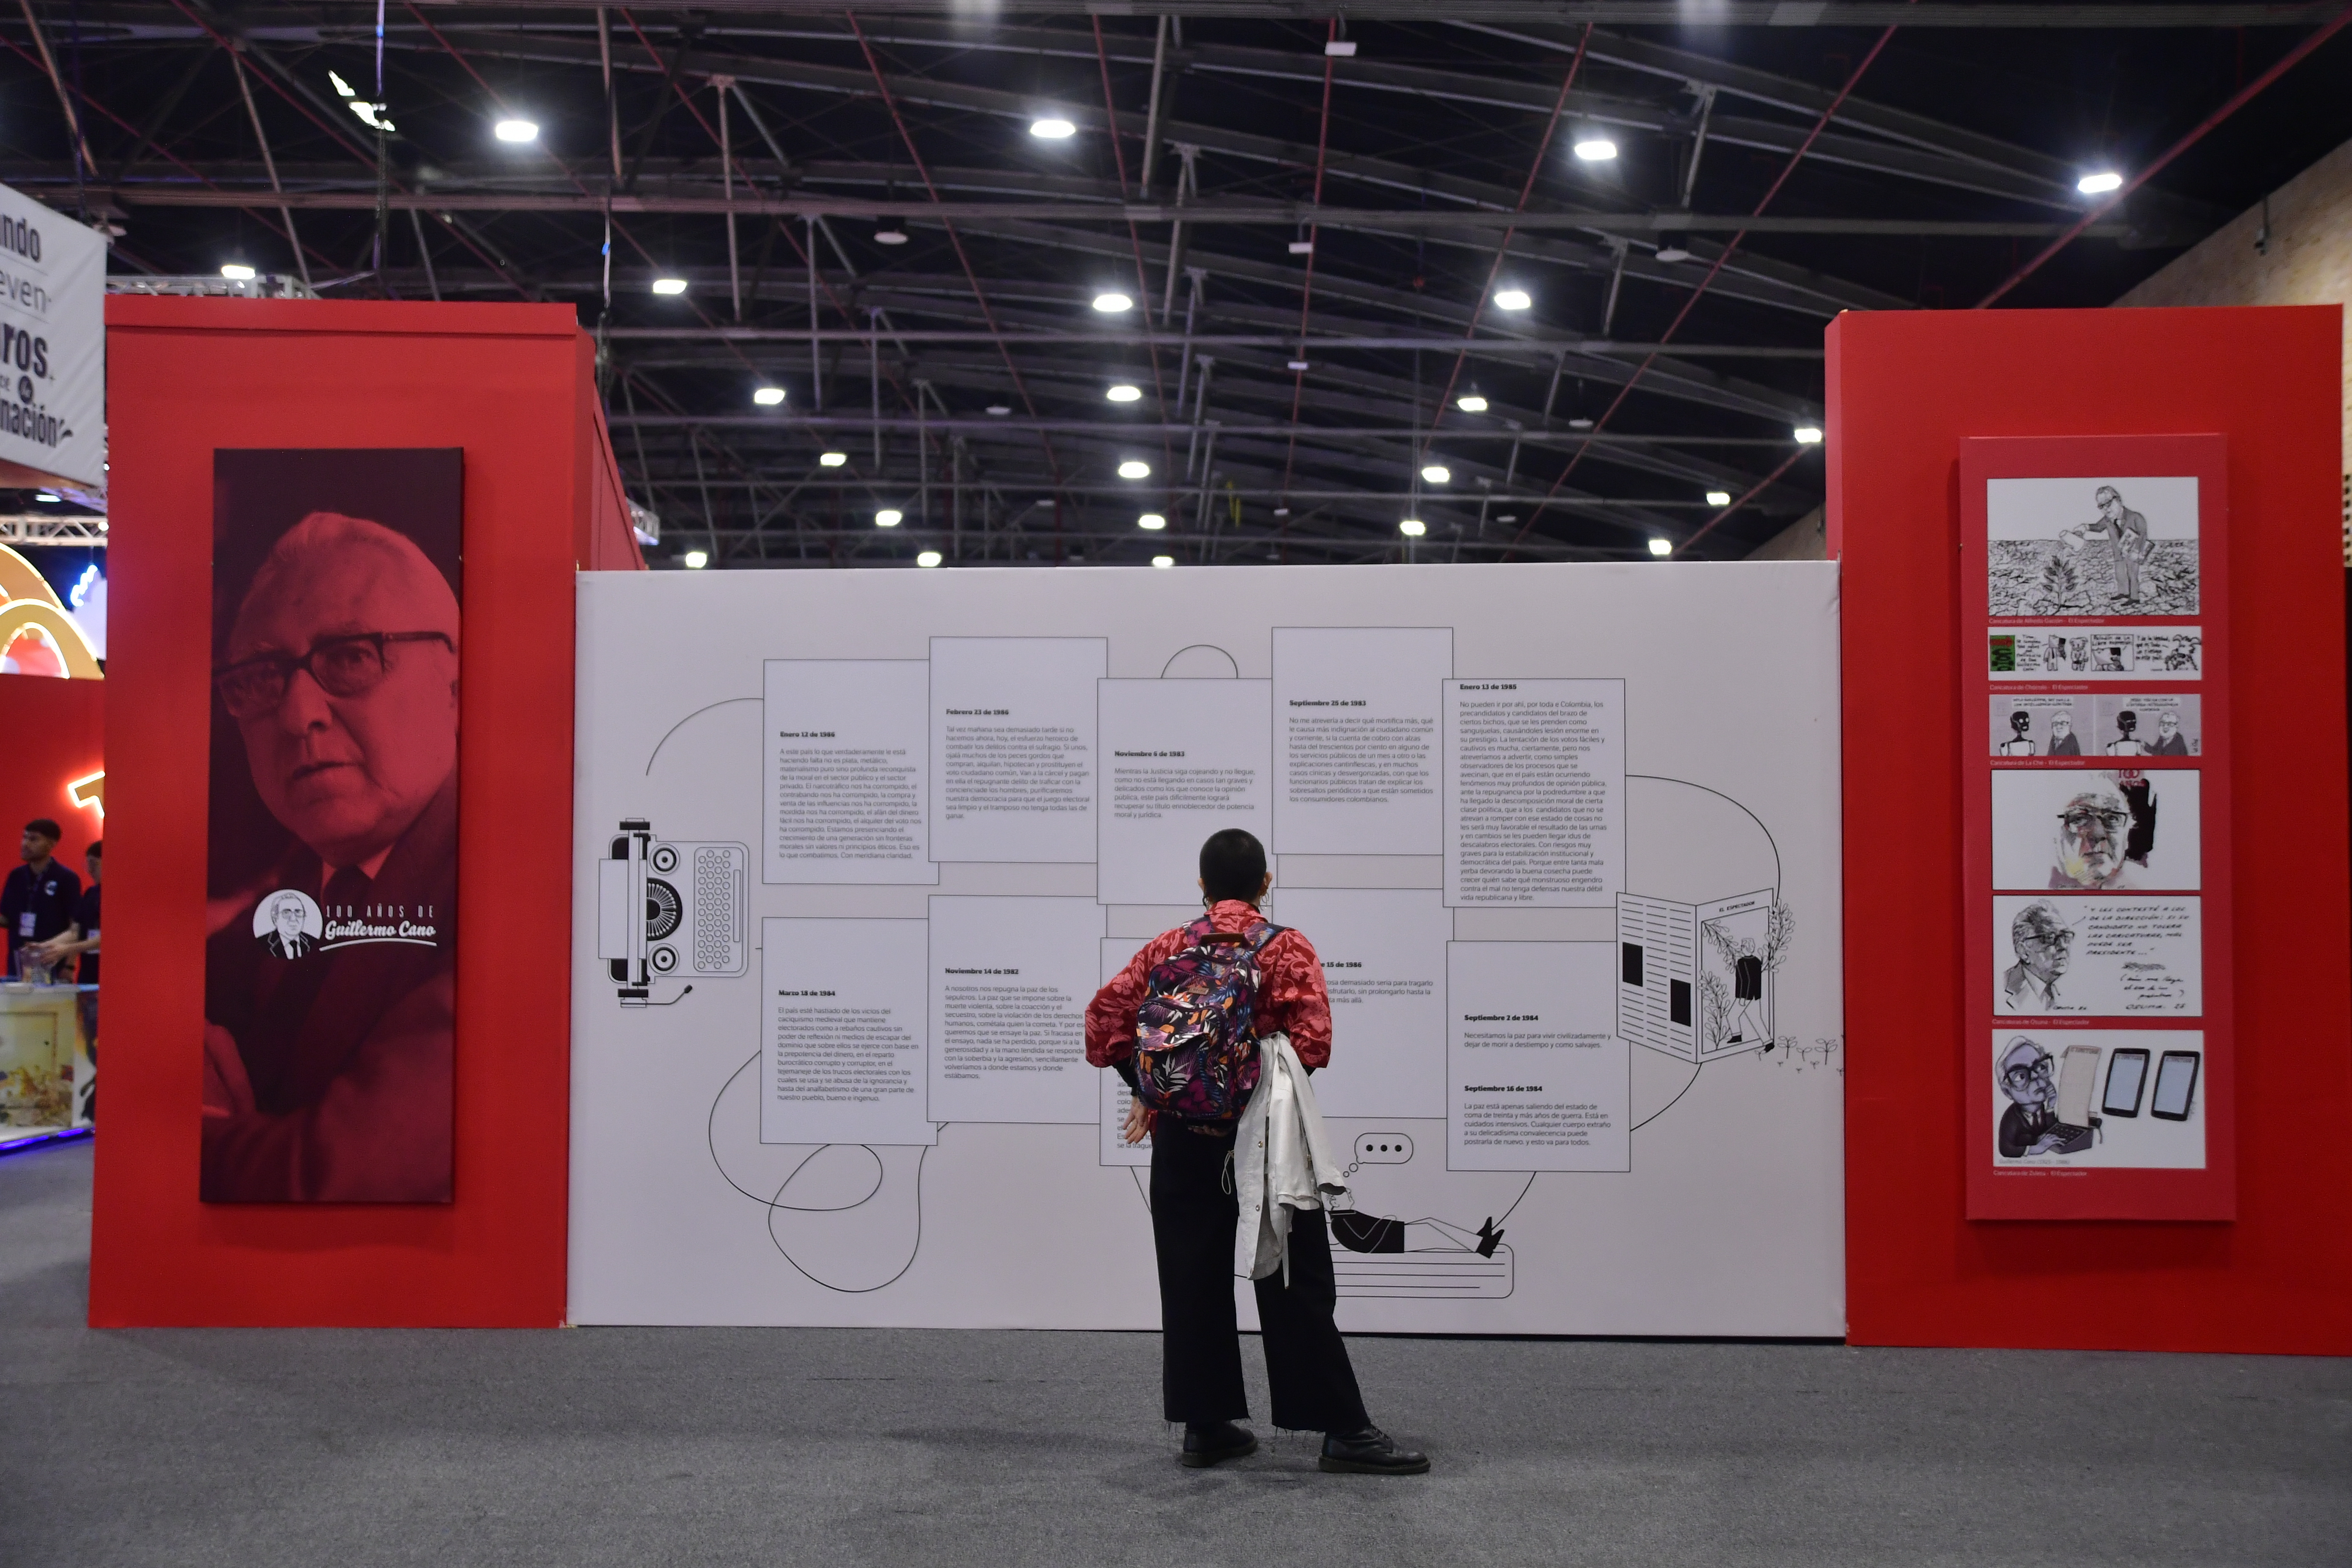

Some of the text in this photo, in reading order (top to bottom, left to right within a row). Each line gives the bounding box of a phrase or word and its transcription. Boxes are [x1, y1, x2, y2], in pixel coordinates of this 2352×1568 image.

[1362, 717, 1375, 725] qué
[1421, 717, 1433, 725] qué
[1727, 901, 1755, 910] ESPECTADOR
[326, 903, 433, 918] 100 AÑOS DE
[325, 919, 436, 940] Guillermo Cano
[1368, 988, 1406, 996] prolongarlo
[1464, 1014, 1505, 1022] Septiembre
